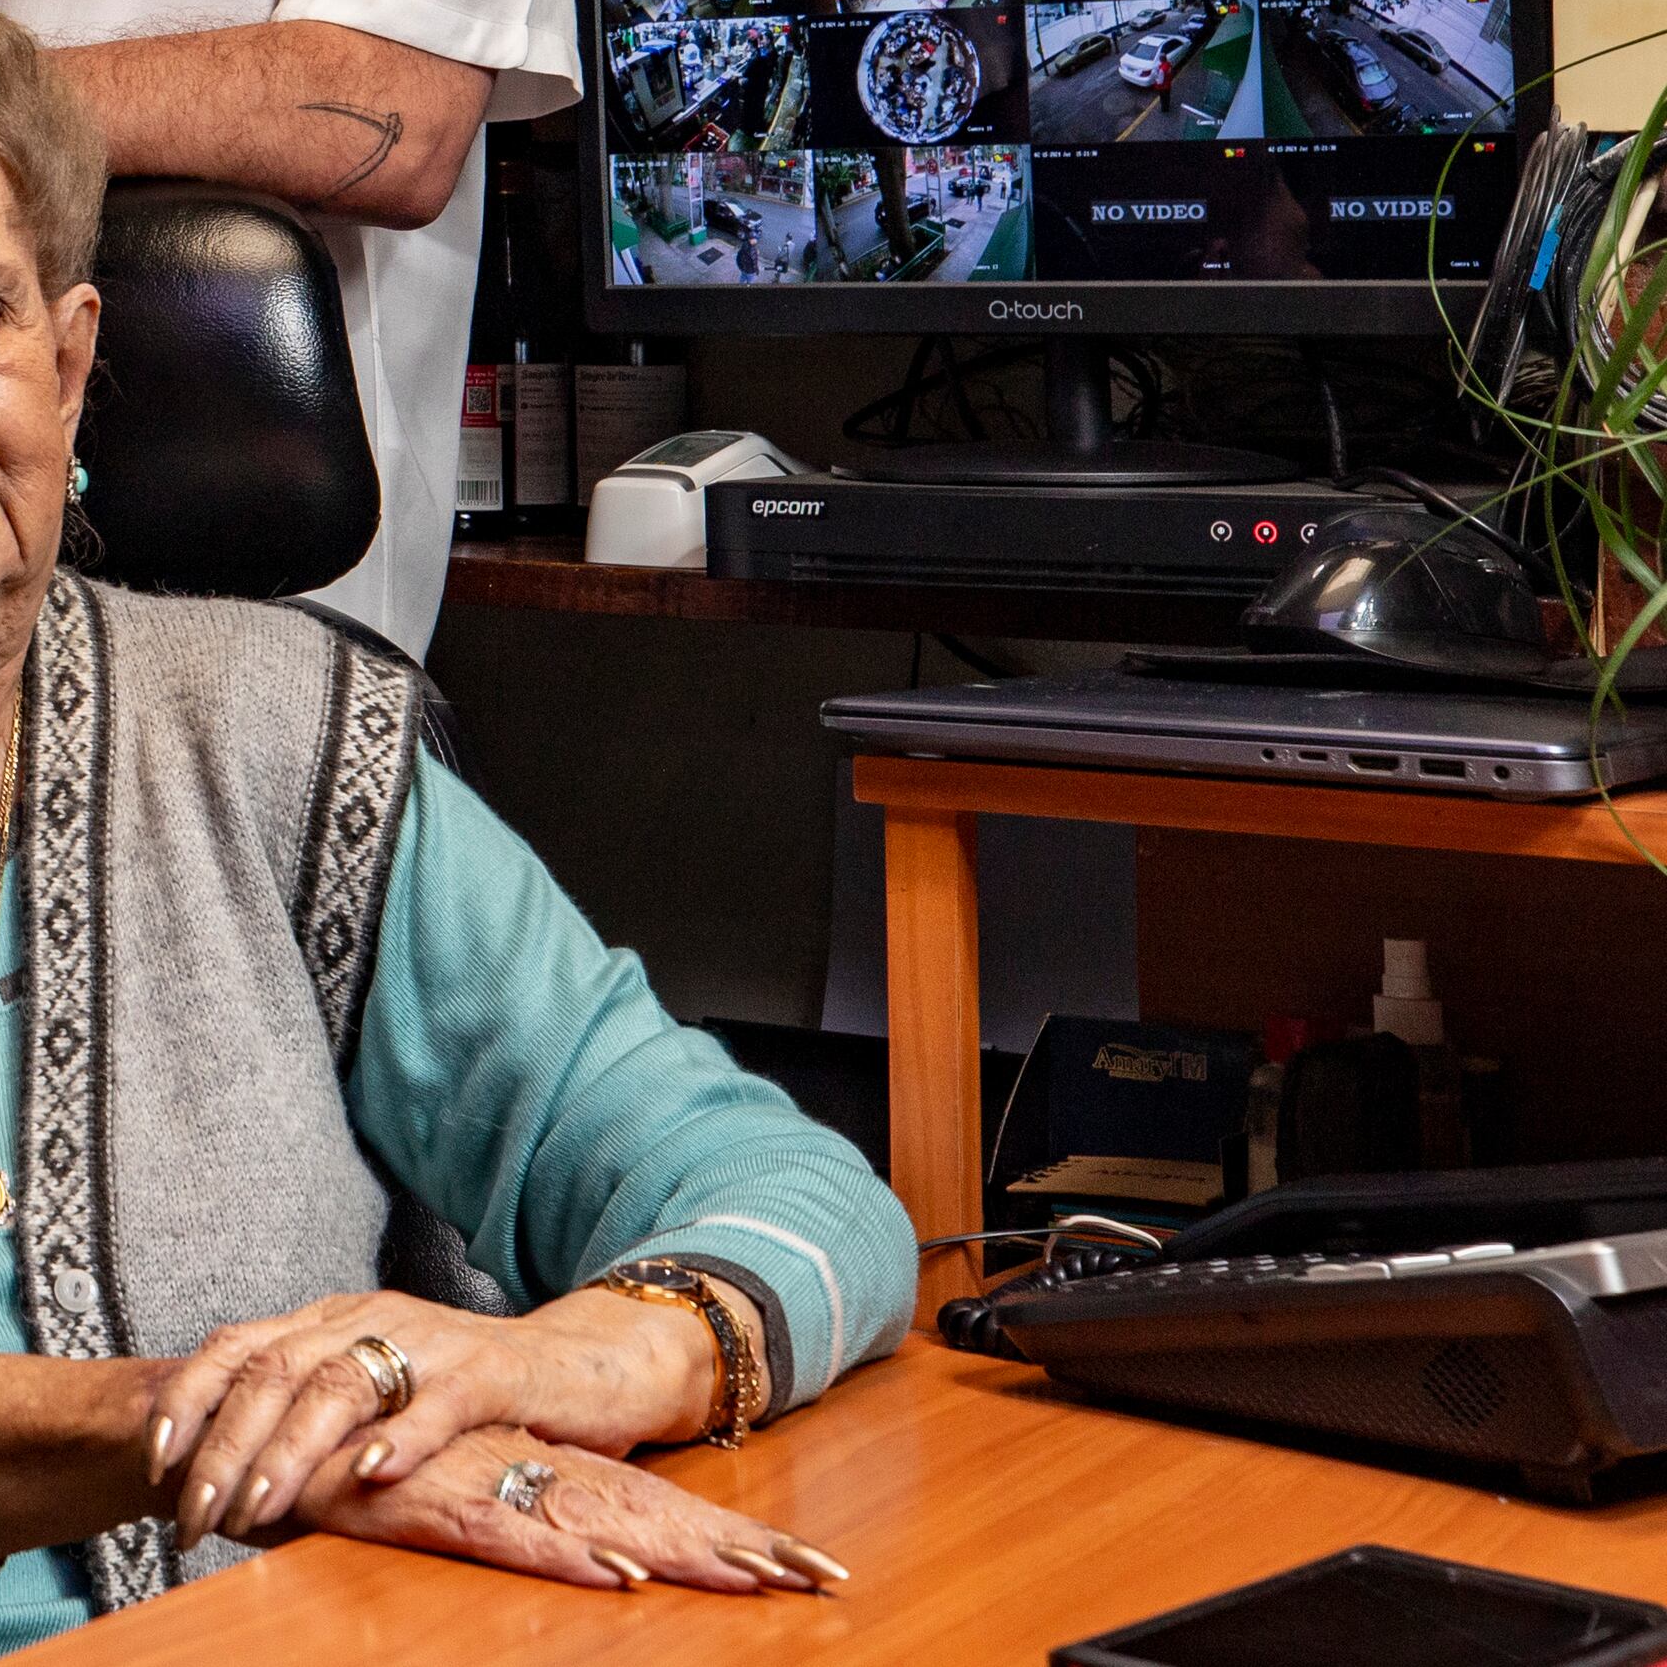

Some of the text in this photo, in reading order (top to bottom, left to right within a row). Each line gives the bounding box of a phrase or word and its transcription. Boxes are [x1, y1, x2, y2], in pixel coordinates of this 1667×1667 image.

[1092, 204, 1205, 222] NO VIDEO
[1330, 200, 1452, 218] NO VIDEO
[752, 498, 821, 519] epcom
